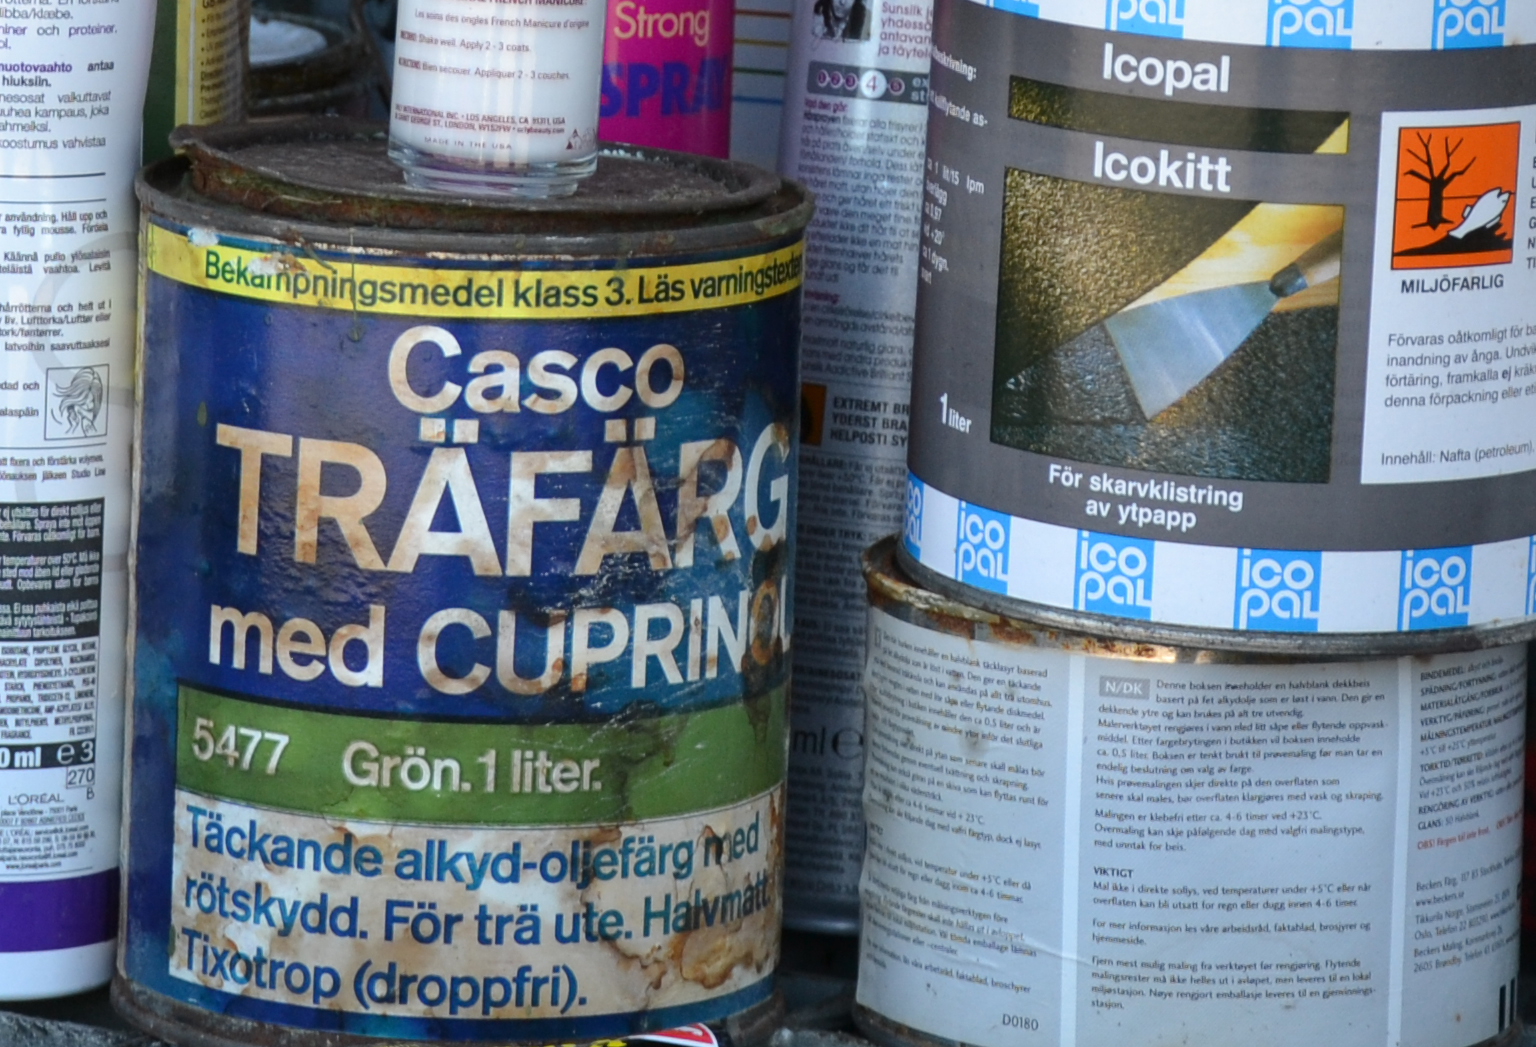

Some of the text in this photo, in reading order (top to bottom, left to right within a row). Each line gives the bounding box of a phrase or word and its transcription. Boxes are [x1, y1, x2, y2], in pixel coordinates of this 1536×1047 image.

[613, 1, 710, 47] Strong
[882, 2, 922, 17] Sunsilk
[1102, 43, 1231, 96] Icopal
[1093, 141, 1232, 193] Icokitt
[514, 278, 599, 309] klass
[605, 277, 634, 308] 3.
[637, 274, 686, 305] Läs
[1400, 272, 1505, 294] MILJÖFARLIG
[1388, 331, 1444, 347] Förvaras
[386, 324, 685, 416] Casco
[1387, 352, 1451, 368] inandning
[833, 397, 888, 414] EXTREMT
[1385, 388, 1498, 409] denna förpackning
[831, 428, 887, 445] HELPOSTI
[1440, 449, 1471, 463] Nafta
[214, 416, 792, 578] TRÄFÄRG
[1049, 463, 1244, 512] För skarvklistring
[1085, 498, 1197, 532] av ytpapp
[1081, 531, 1147, 577] ico
[1242, 549, 1314, 589] ico
[208, 601, 387, 689] med
[1105, 680, 1143, 694] N/DK
[14, 746, 42, 768] ml
[191, 717, 603, 794] 5477 Grön. liter.
[68, 767, 95, 786] 270
[8, 793, 64, 806] L'ORÉAL
[185, 804, 692, 892] Täckande alkyd-oljefärg
[1093, 866, 1134, 879] VIKTIGT
[184, 875, 369, 940] rötskydd.
[384, 899, 462, 946] För
[474, 904, 542, 947] trä
[554, 909, 634, 943] ute.
[180, 927, 588, 1017] Tixotrop (droppfri).
